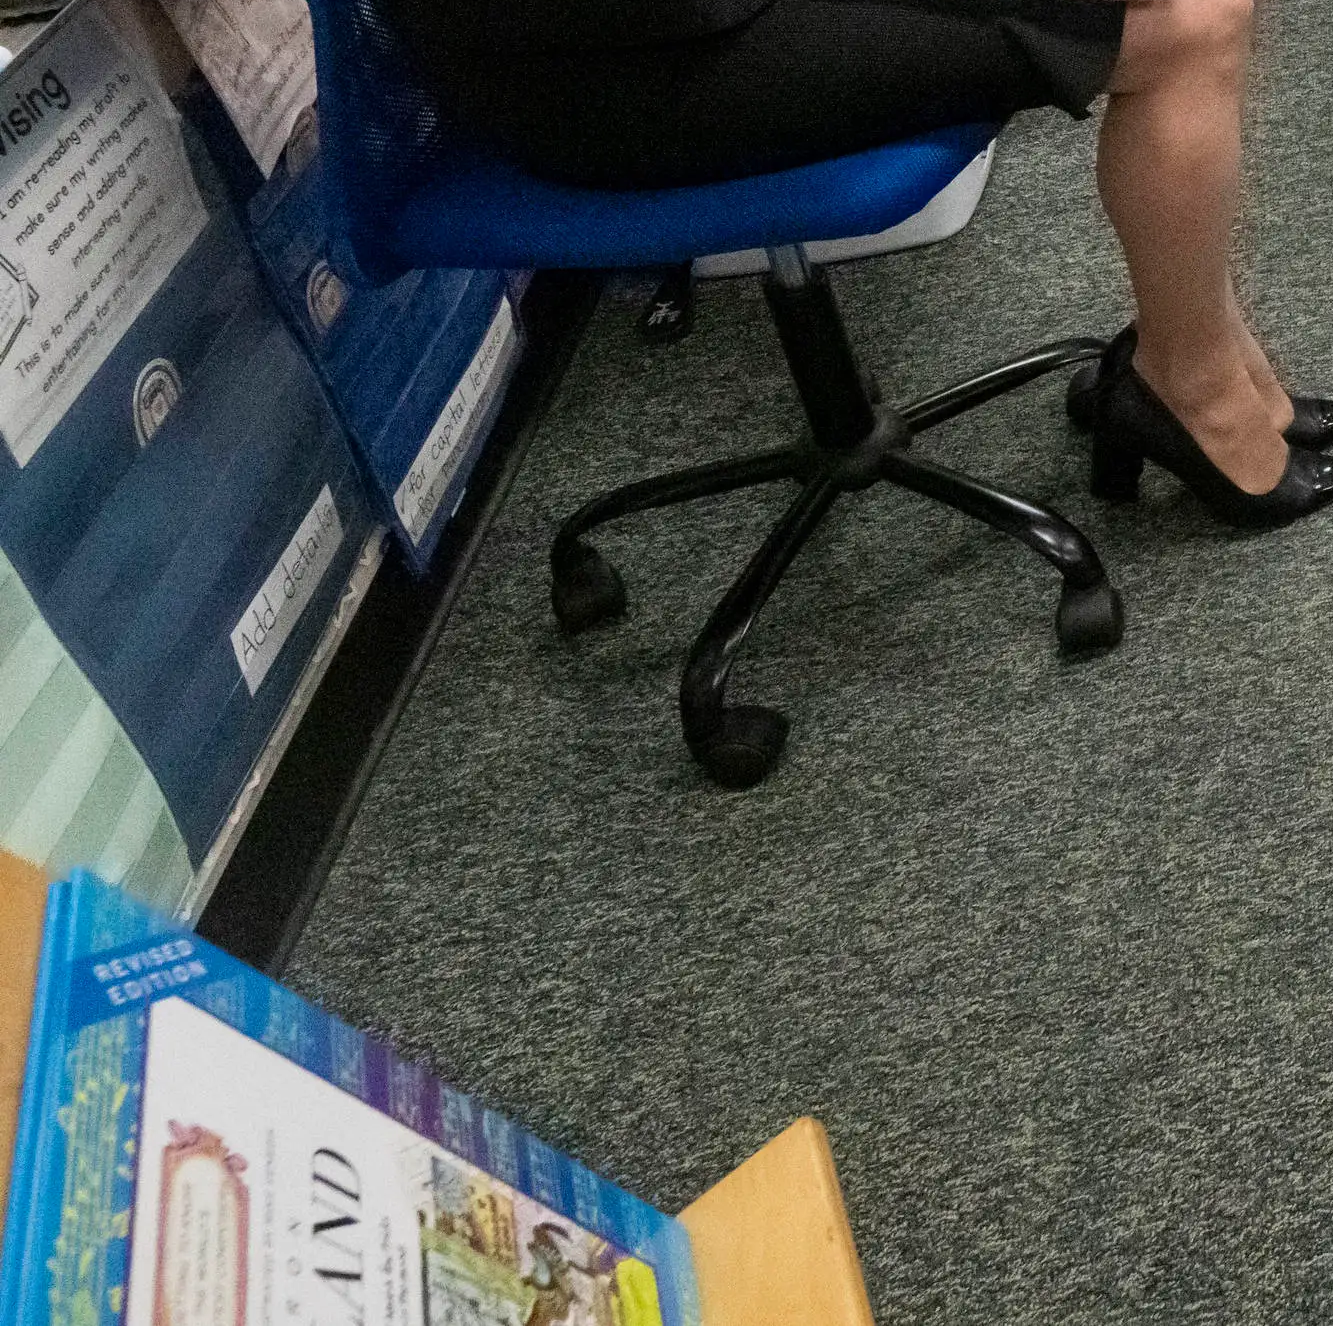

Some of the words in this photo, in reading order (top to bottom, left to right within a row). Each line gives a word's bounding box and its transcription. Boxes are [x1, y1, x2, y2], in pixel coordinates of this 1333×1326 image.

[7, 190, 26, 211] am
[25, 130, 81, 192] re-reading
[79, 111, 96, 135] my
[16, 211, 45, 247] make
[45, 185, 69, 214] sure
[69, 164, 87, 187] my
[86, 130, 122, 168] writing
[119, 99, 149, 133] makes
[47, 222, 76, 257] sense
[77, 194, 96, 222] and
[96, 163, 127, 201] adding
[71, 207, 122, 270] interesting
[15, 353, 41, 379] This
[41, 341, 51, 356] is
[51, 323, 64, 341] to
[64, 289, 90, 324] make
[90, 265, 112, 293] sure
[111, 244, 128, 267] my
[42, 321, 98, 394] entertaining
[97, 297, 112, 321] for
[408, 465, 428, 496] for
[431, 389, 468, 460] capital
[239, 593, 277, 666] Add
[282, 504, 334, 599] details
[94, 940, 194, 983] REVISED
[107, 960, 208, 1006] EDITION
